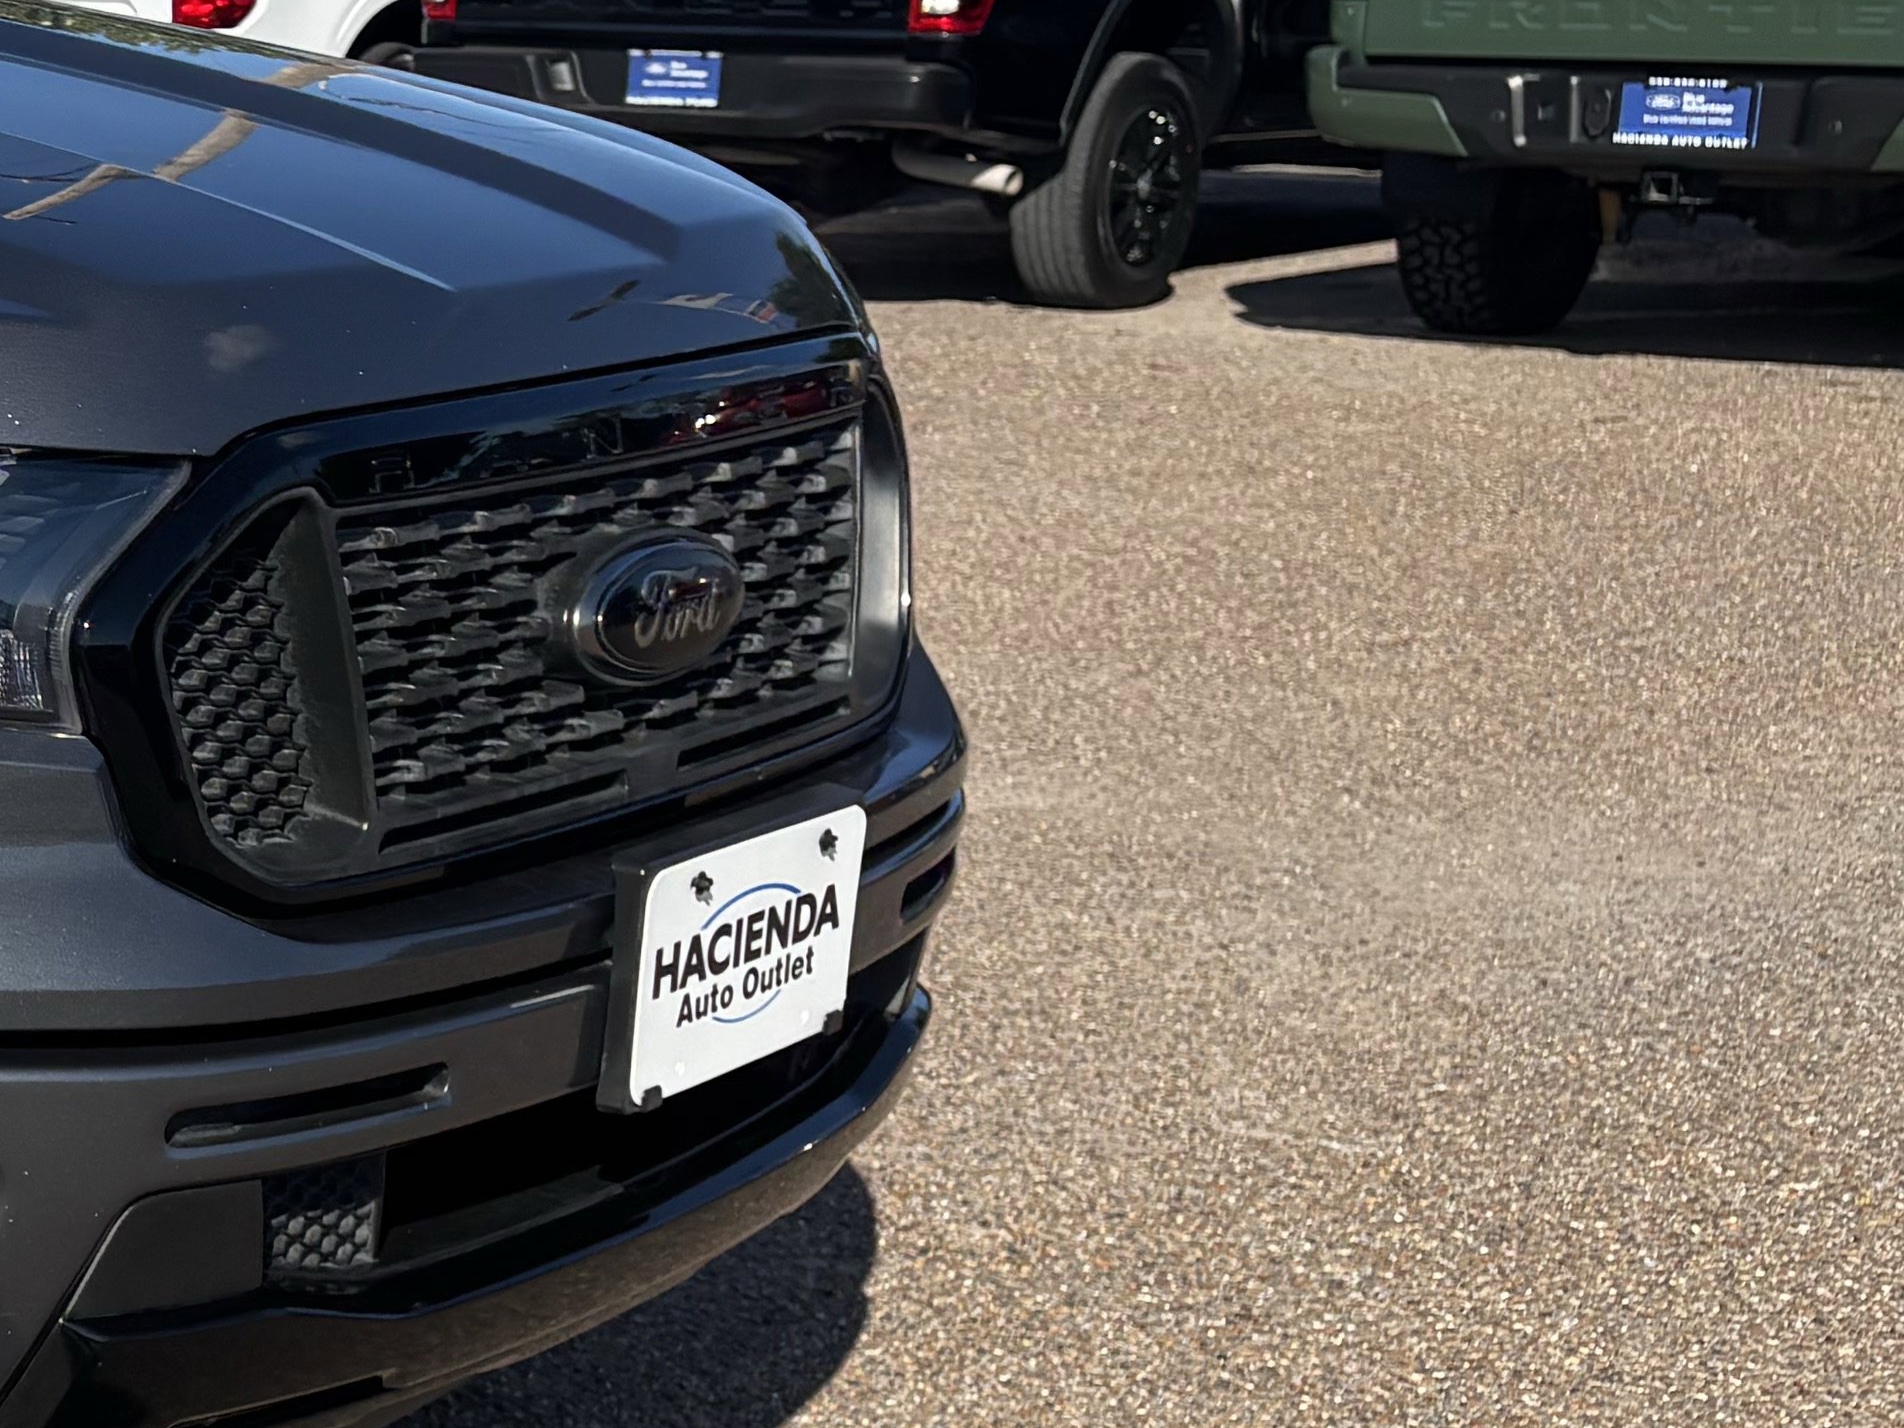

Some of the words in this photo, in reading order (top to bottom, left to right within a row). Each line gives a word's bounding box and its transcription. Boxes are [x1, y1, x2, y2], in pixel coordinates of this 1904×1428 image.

[634, 566, 722, 649] Ford
[651, 884, 840, 1001] HACIENDA
[676, 982, 734, 1028] Auto
[742, 945, 815, 1000] Outlet
